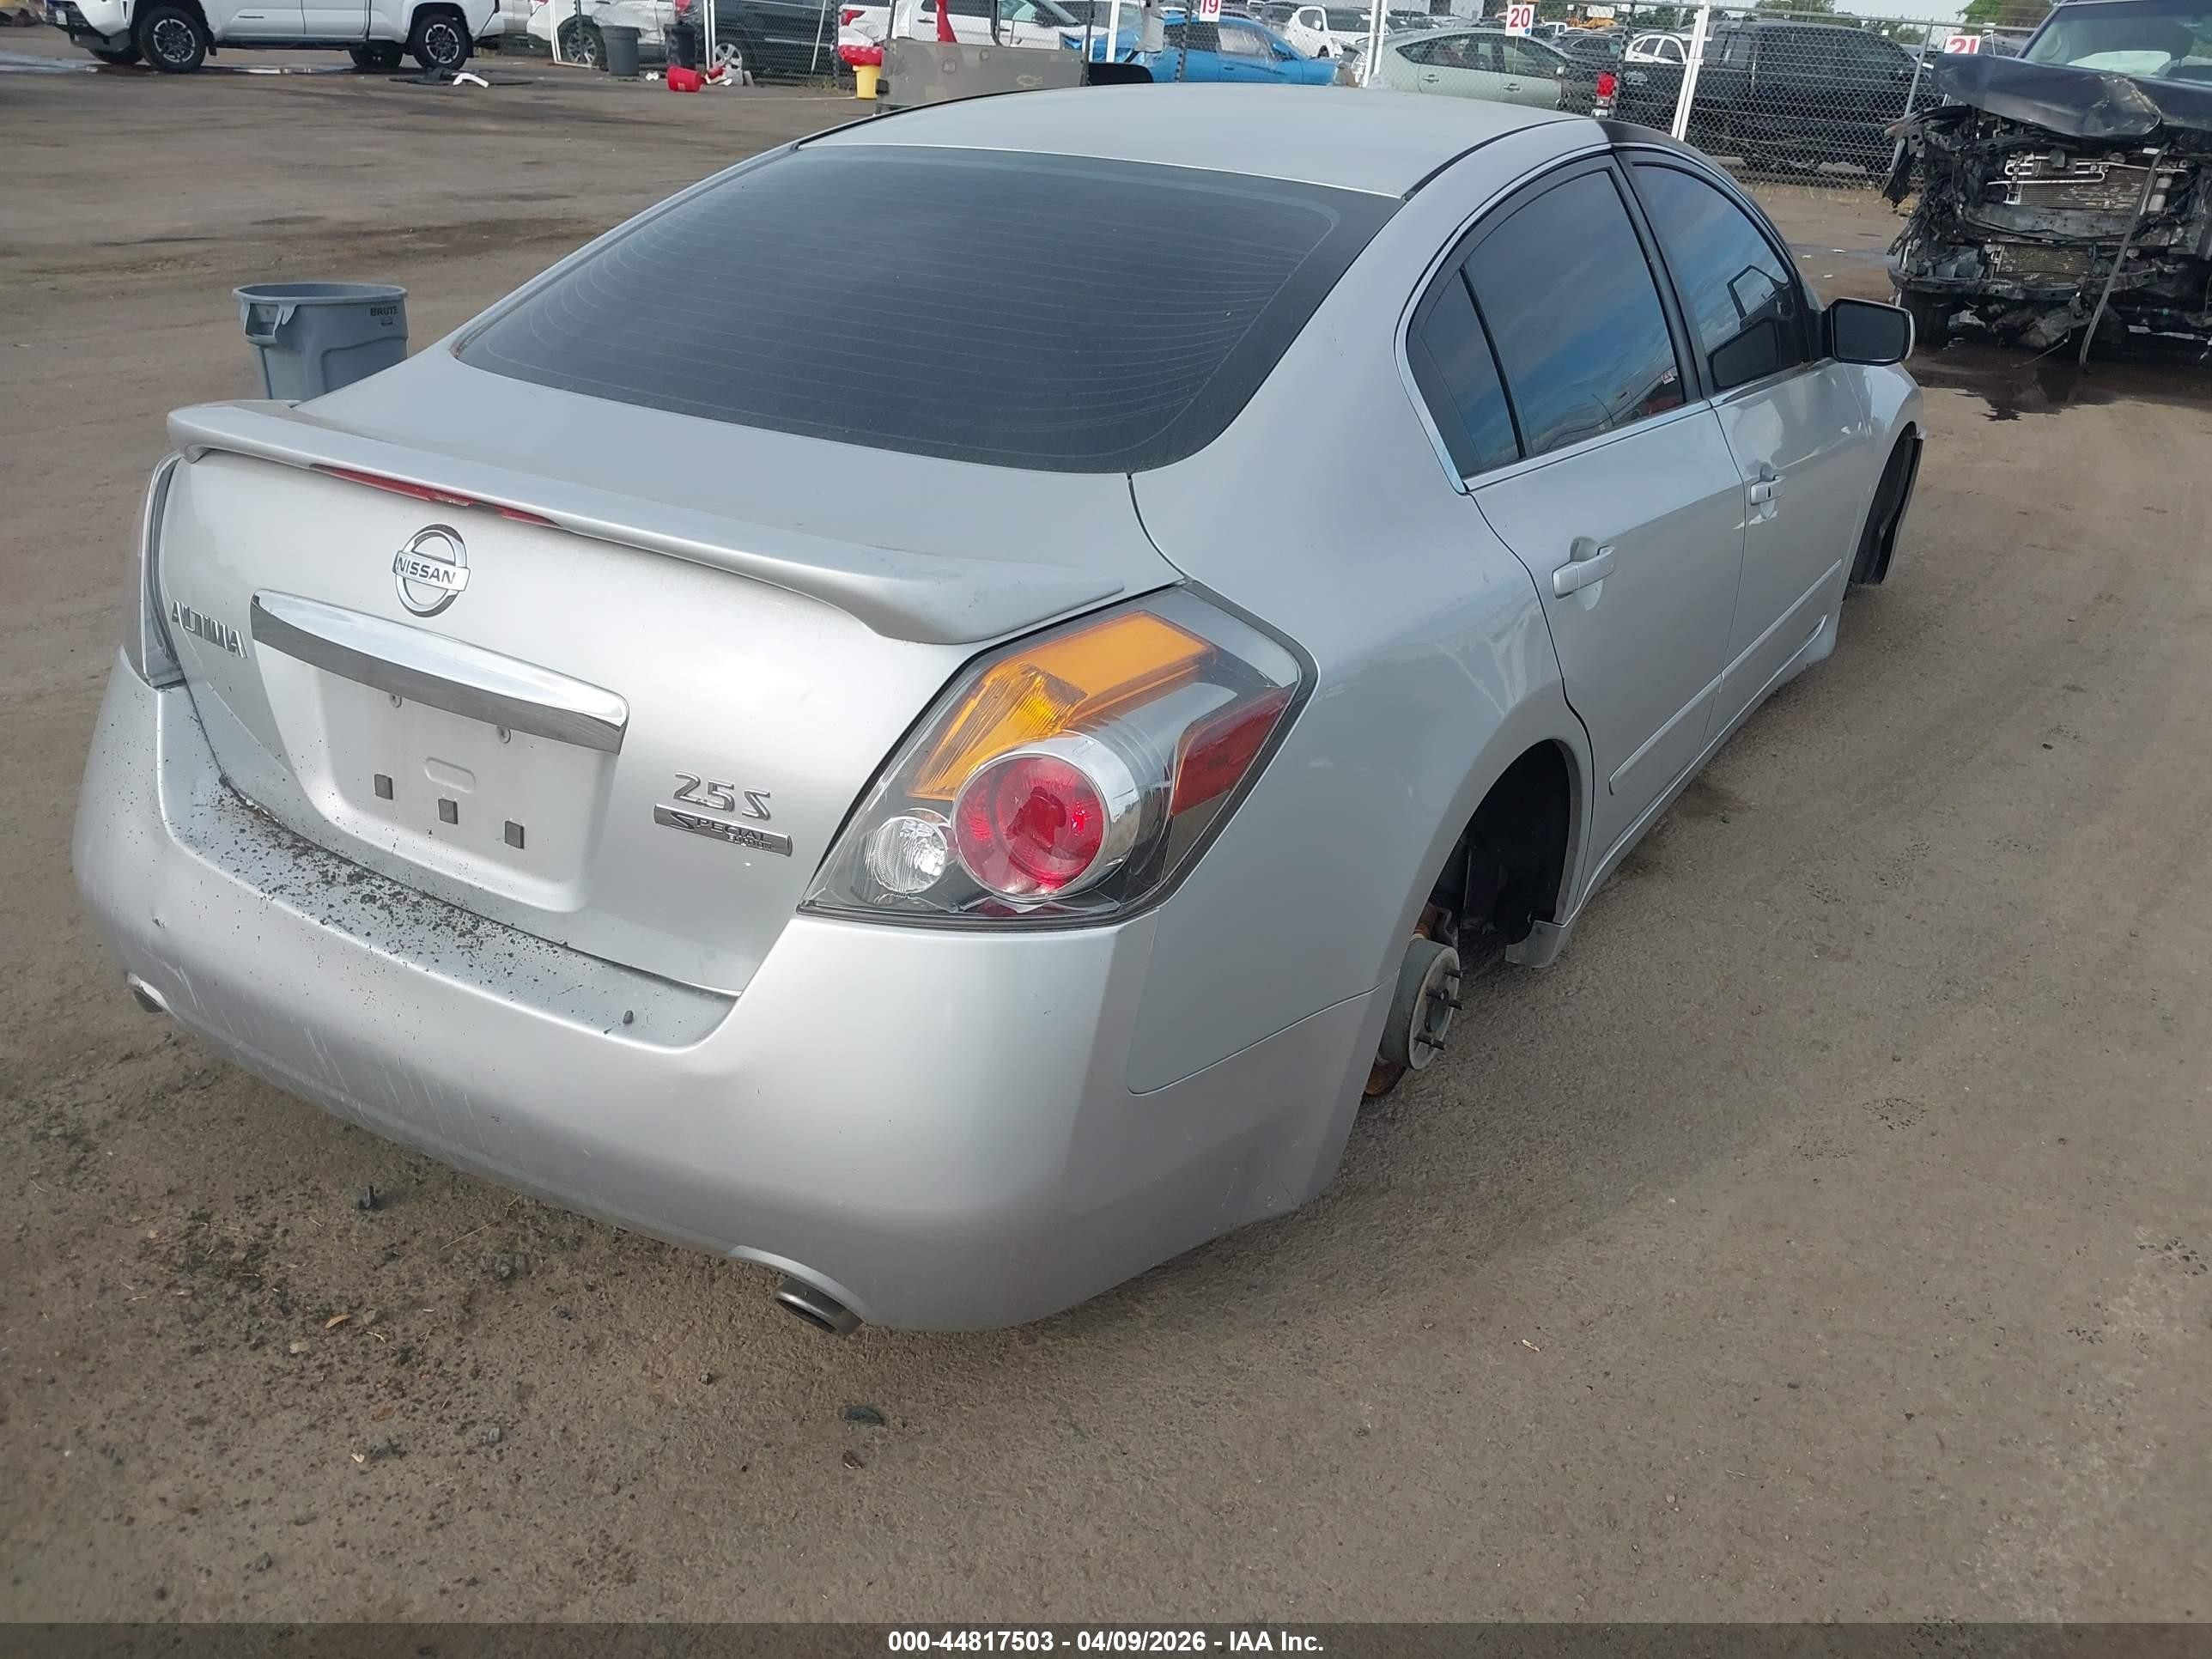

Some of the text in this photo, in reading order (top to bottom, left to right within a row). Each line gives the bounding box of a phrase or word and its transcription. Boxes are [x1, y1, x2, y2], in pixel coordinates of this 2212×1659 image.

[1202, 0, 1218, 14] 19
[1510, 7, 1530, 27] 20
[1950, 38, 1978, 55] 21
[370, 306, 399, 317] BRUTE
[396, 556, 457, 585] NISSAN
[171, 599, 248, 659] ALTIMA
[673, 771, 772, 821] 2.5 S
[669, 811, 773, 845] SPECIAL
